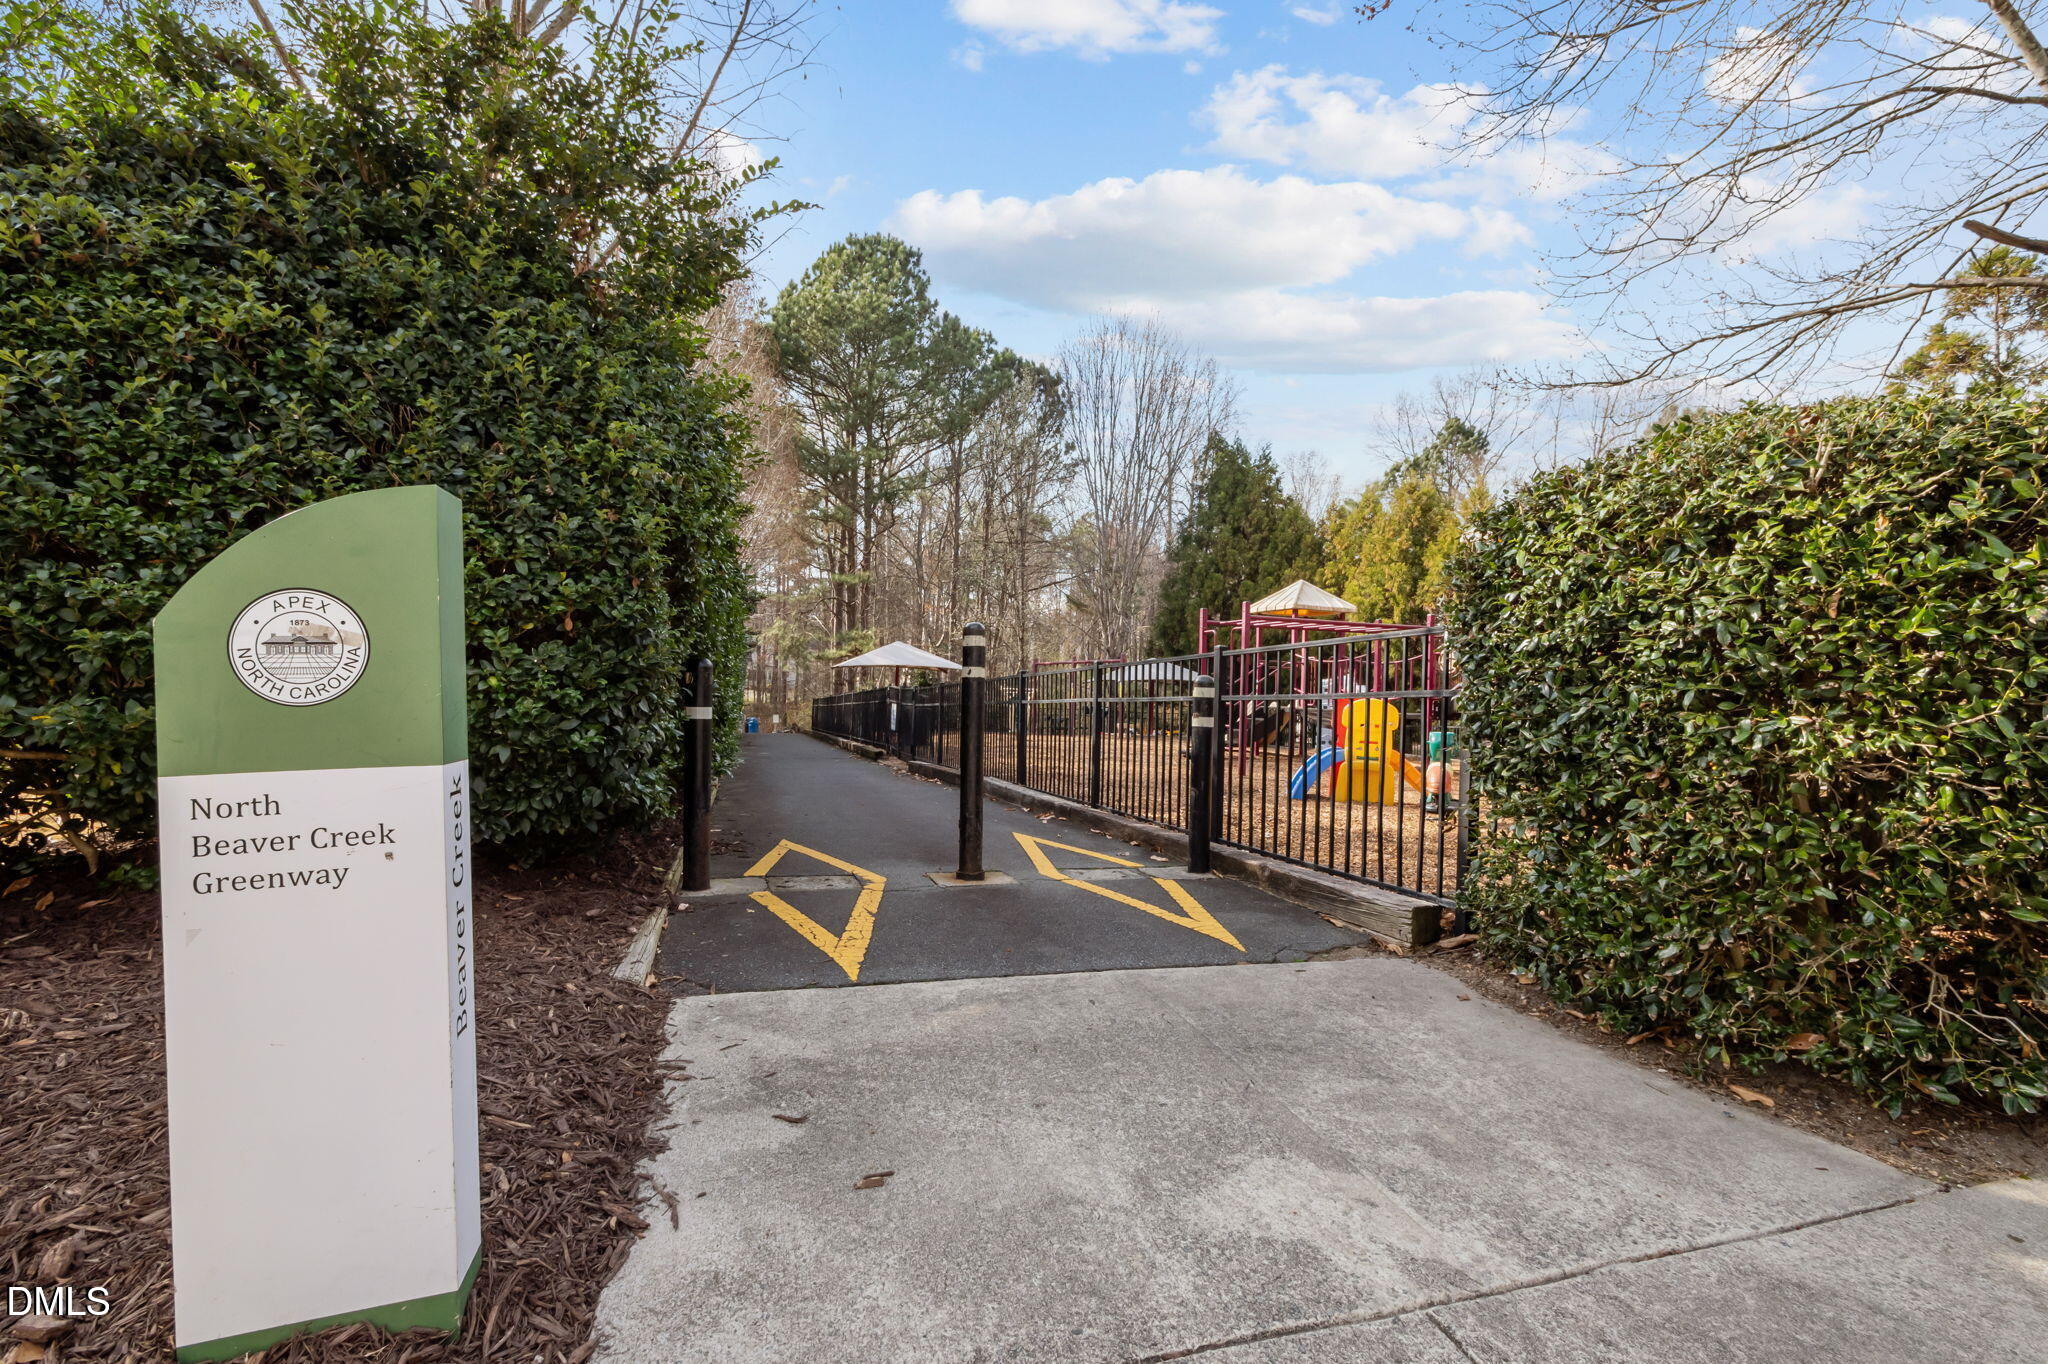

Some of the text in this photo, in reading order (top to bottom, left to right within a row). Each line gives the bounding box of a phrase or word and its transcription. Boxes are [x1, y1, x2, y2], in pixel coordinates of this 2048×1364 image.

[272, 596, 332, 614] APEX
[237, 646, 361, 699] NORTH CAROLINA
[190, 794, 282, 820] North
[192, 823, 396, 858] Beaver Creek
[193, 867, 350, 895] Greenway
[450, 774, 468, 1039] Beaver Creek
